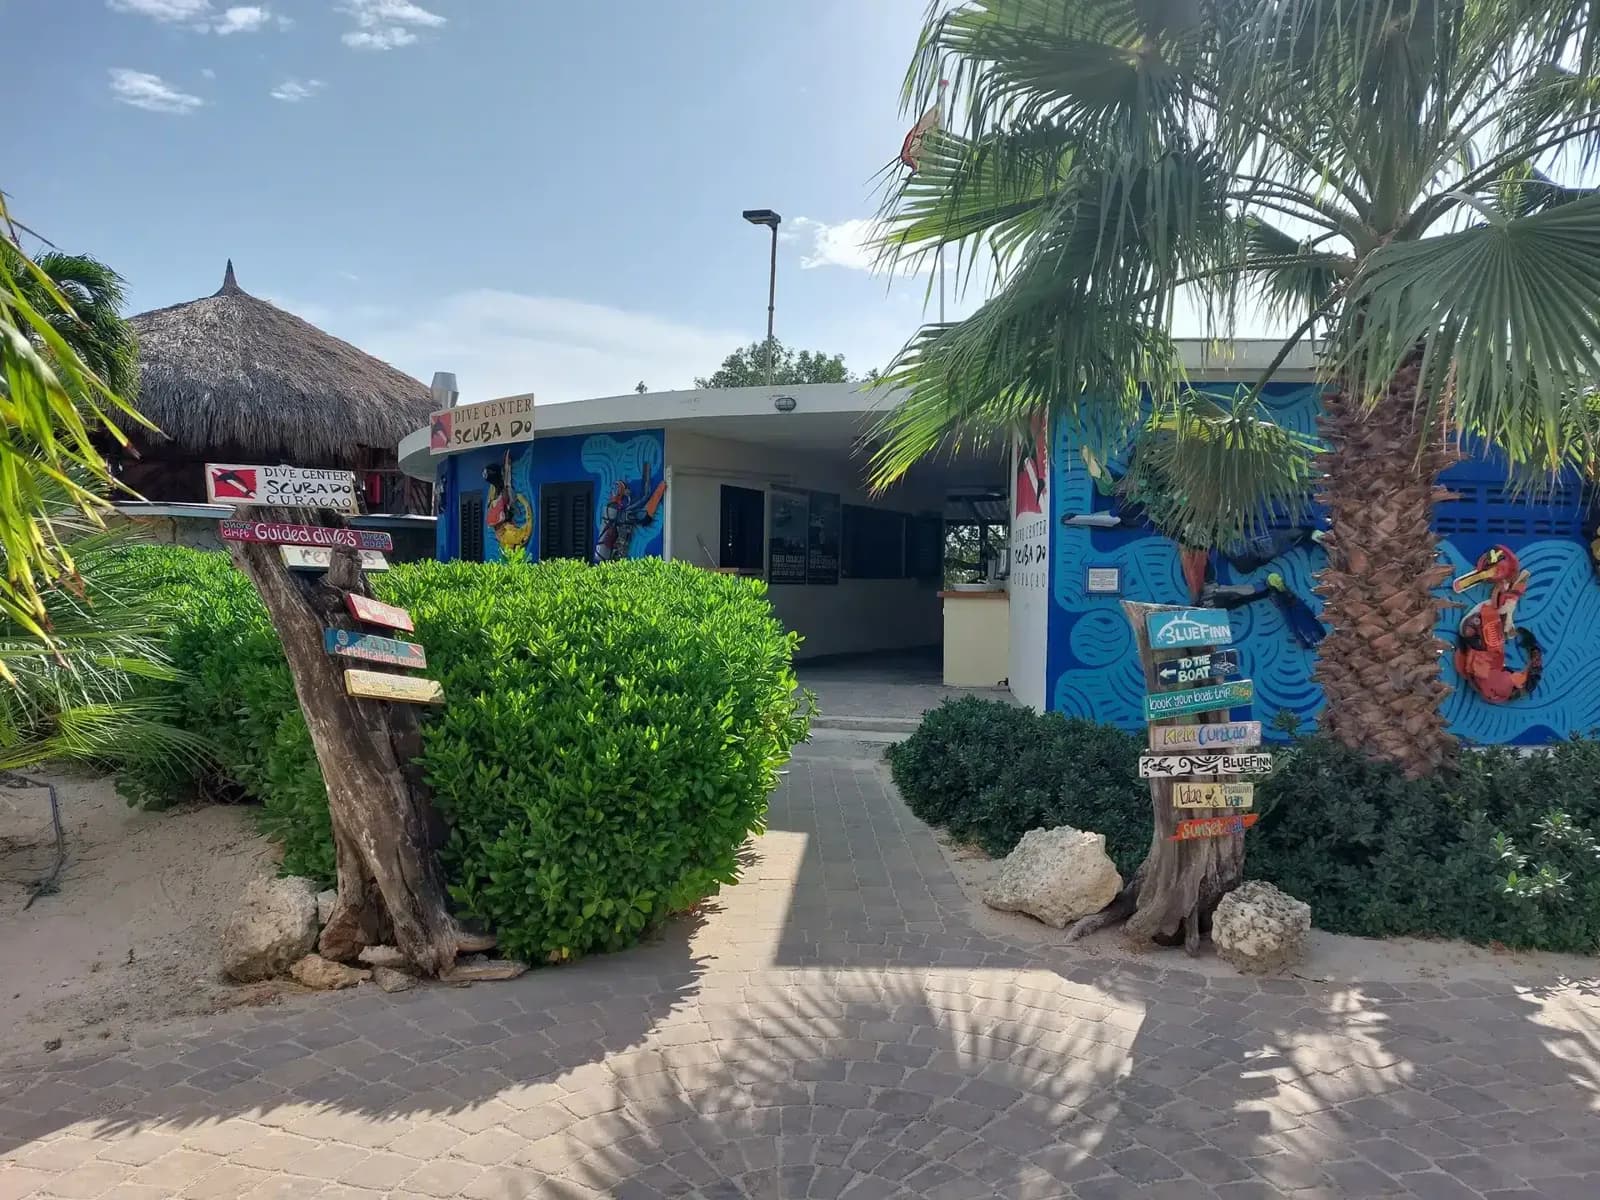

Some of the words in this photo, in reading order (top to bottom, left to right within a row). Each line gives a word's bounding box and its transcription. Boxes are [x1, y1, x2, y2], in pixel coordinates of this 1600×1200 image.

[455, 407, 480, 424] DIVE
[484, 398, 531, 418] CENTER
[455, 421, 501, 444] SCUBA
[510, 420, 532, 437] DO
[264, 467, 296, 478] DIVE
[302, 470, 349, 481] CENTER
[223, 528, 250, 538] drift
[254, 523, 309, 542] Guided
[313, 528, 357, 547] dives
[1177, 657, 1192, 669] TO
[1193, 654, 1211, 665] THE
[1177, 666, 1211, 682] BOAT
[1149, 696, 1174, 710] book
[1193, 689, 1214, 702] boat
